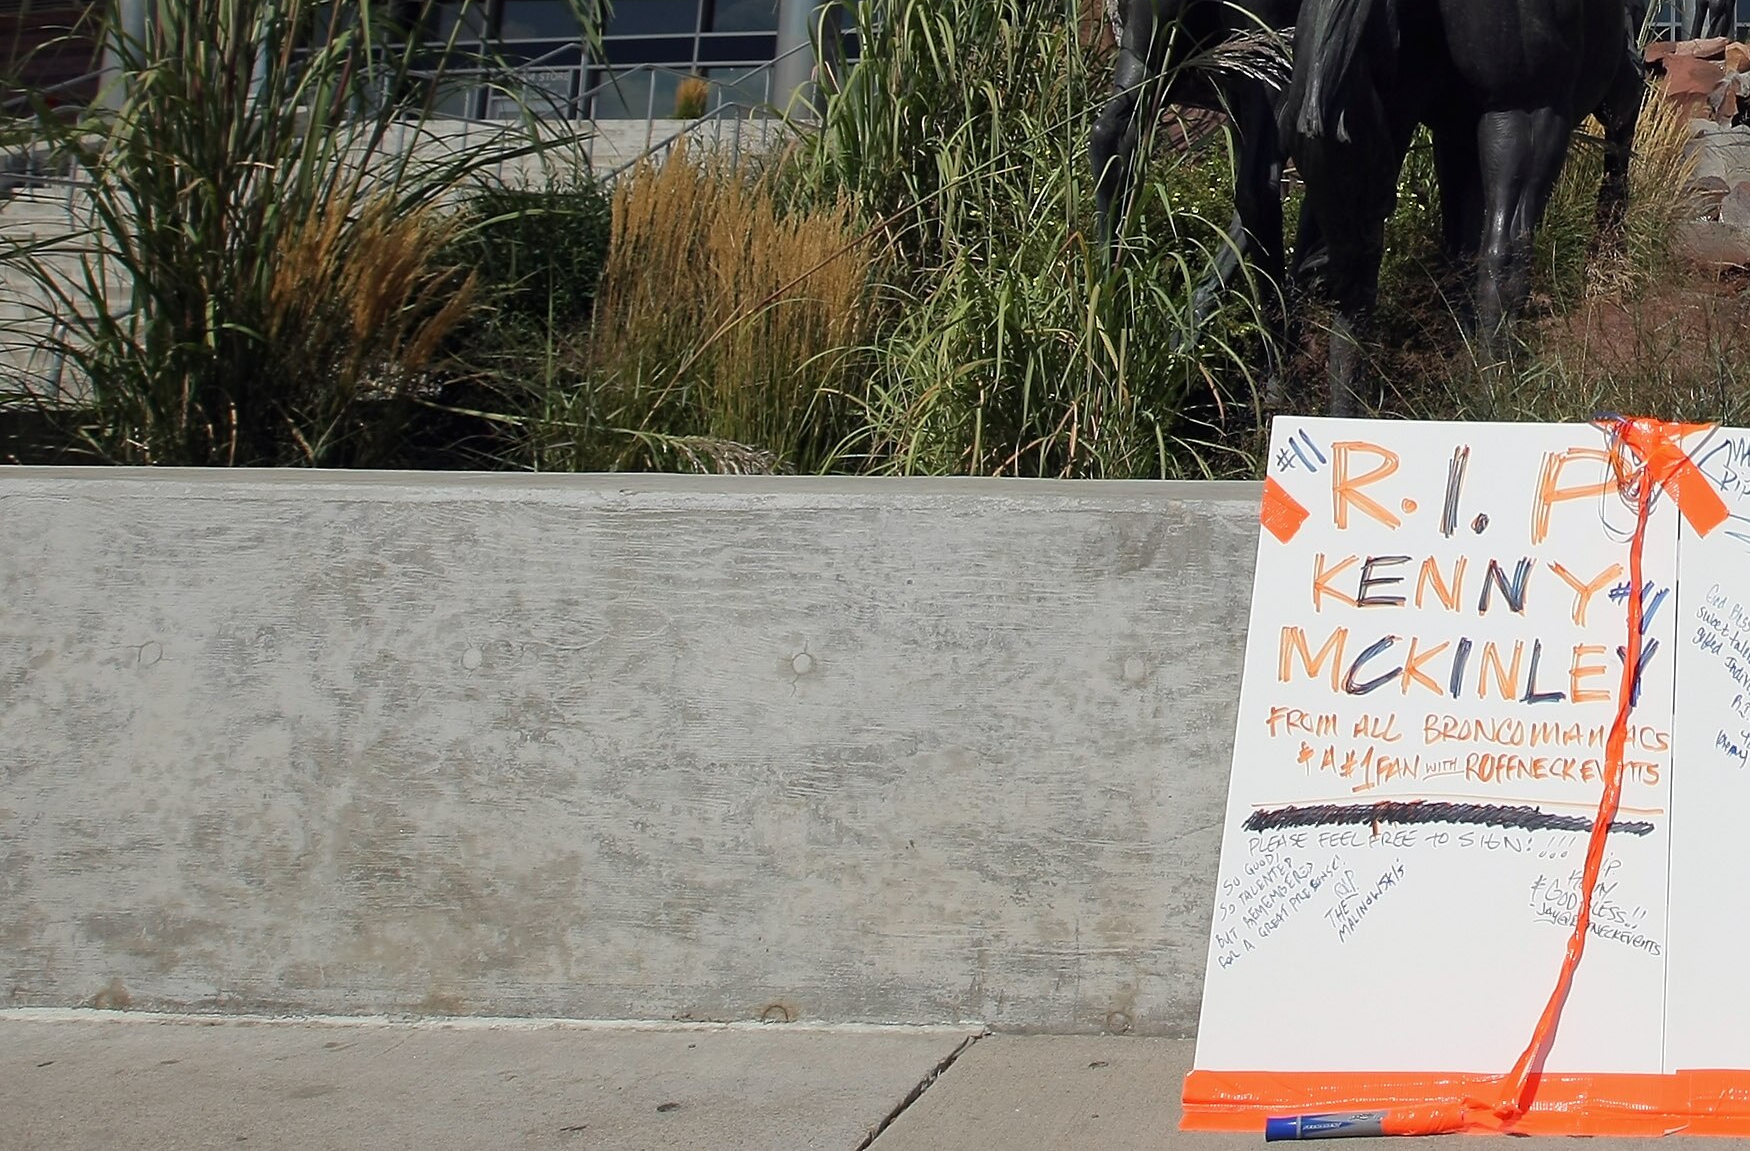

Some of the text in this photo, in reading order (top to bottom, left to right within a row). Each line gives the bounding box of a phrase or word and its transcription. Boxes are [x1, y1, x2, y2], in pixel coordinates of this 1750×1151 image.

[1276, 427, 1327, 473] #11
[1313, 553, 1626, 627] KENNY
[1266, 706, 1339, 738] FROM
[1353, 713, 1402, 742] ALL
[1377, 754, 1421, 786] FAN
[1425, 757, 1460, 773] WITH
[1249, 832, 1309, 857] PLEASE
[1318, 831, 1365, 849] FEEL
[1368, 829, 1419, 849] FREE
[1219, 857, 1293, 922] SO TALENTED
[1223, 875, 1241, 897] SO
[1545, 878, 1578, 911] GOD
[1243, 939, 1256, 952] A
[1258, 905, 1290, 938] GREAT
[1324, 898, 1352, 929] THE
[1215, 926, 1240, 949] BUT
